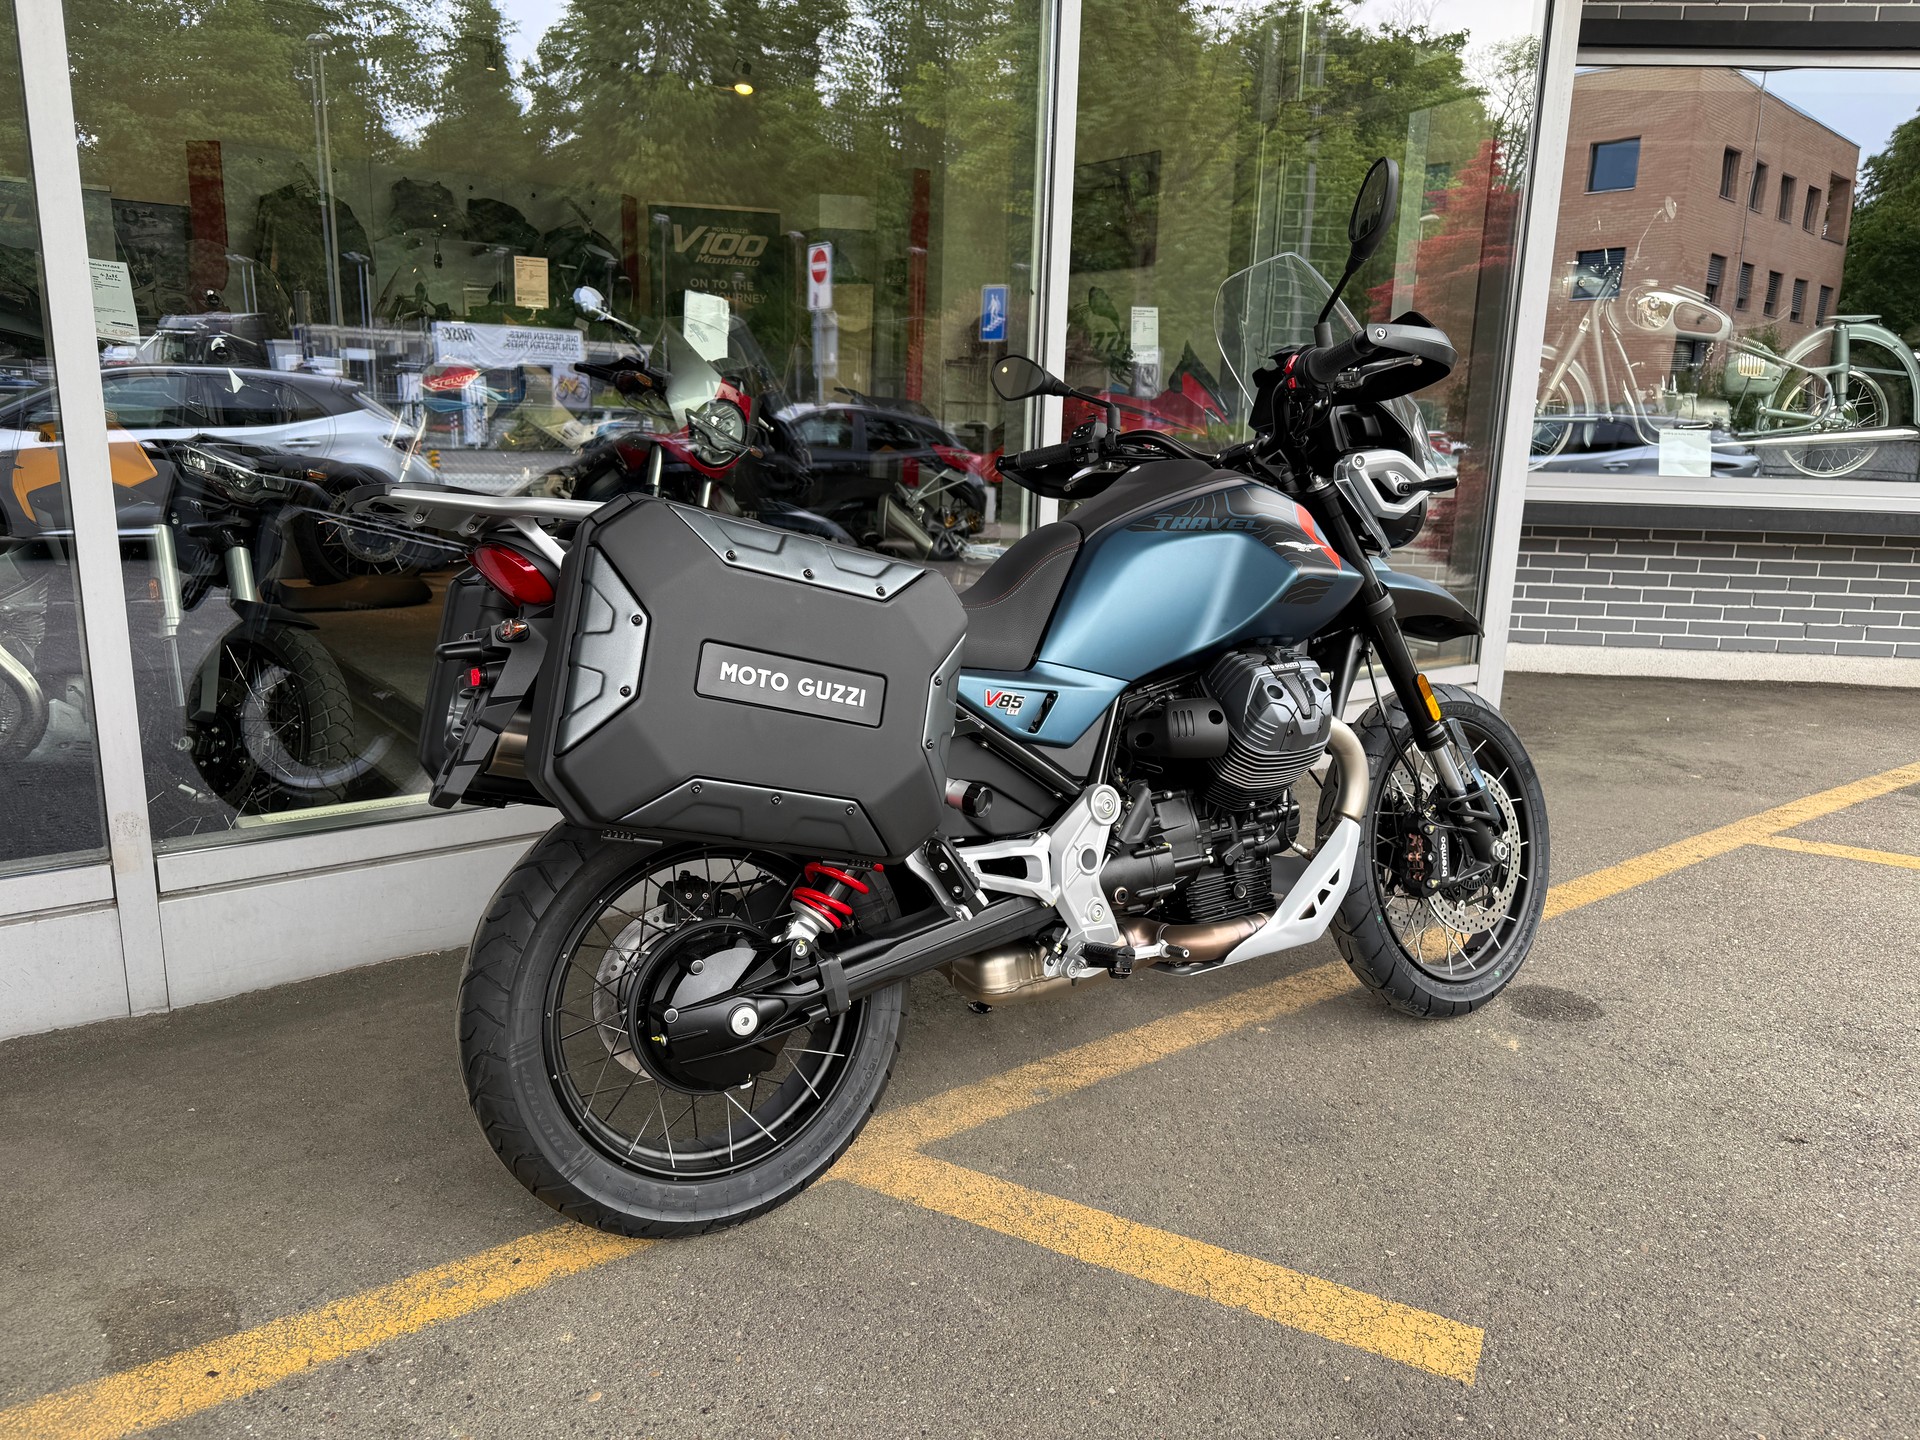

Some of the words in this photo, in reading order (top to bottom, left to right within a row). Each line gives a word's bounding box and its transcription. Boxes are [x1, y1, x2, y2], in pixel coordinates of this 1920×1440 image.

[673, 224, 769, 257] V100
[696, 254, 760, 267] Mandello
[690, 278, 708, 288] ON
[711, 279, 728, 289] TO
[731, 281, 754, 291] THE
[429, 374, 473, 388] STELVIO
[1154, 516, 1261, 530] TRAVEL
[719, 661, 789, 692] MOTO
[797, 677, 866, 708] GUZZI
[985, 689, 1025, 709] V85
[1440, 836, 1448, 878] brembo
[521, 1066, 564, 1148] DUNLOP
